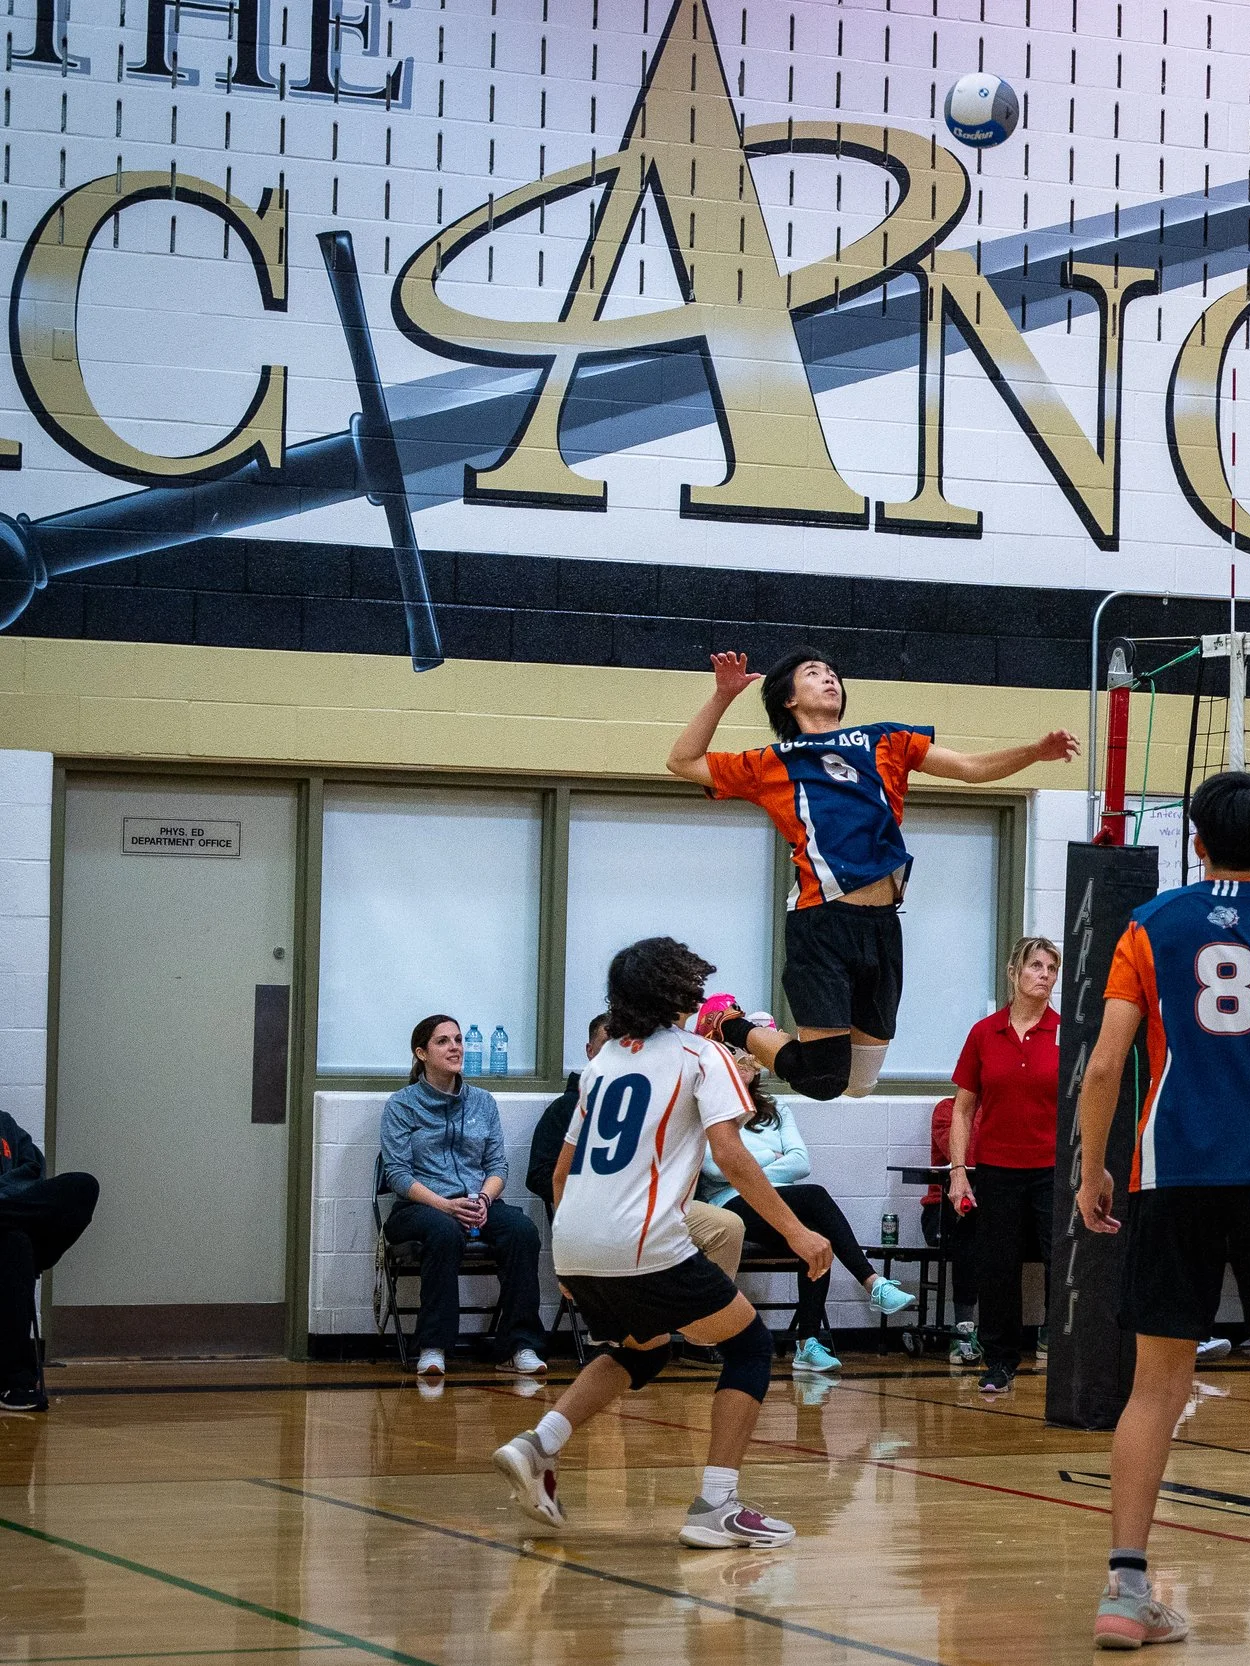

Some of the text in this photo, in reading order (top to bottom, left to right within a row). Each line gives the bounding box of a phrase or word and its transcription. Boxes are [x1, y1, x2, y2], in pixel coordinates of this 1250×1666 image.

[131, 836, 233, 848] DEPARTMENT OFFICE
[160, 827, 205, 837] PHYS. ED
[1071, 878, 1095, 1024] ARC
[568, 1072, 653, 1176] 19
